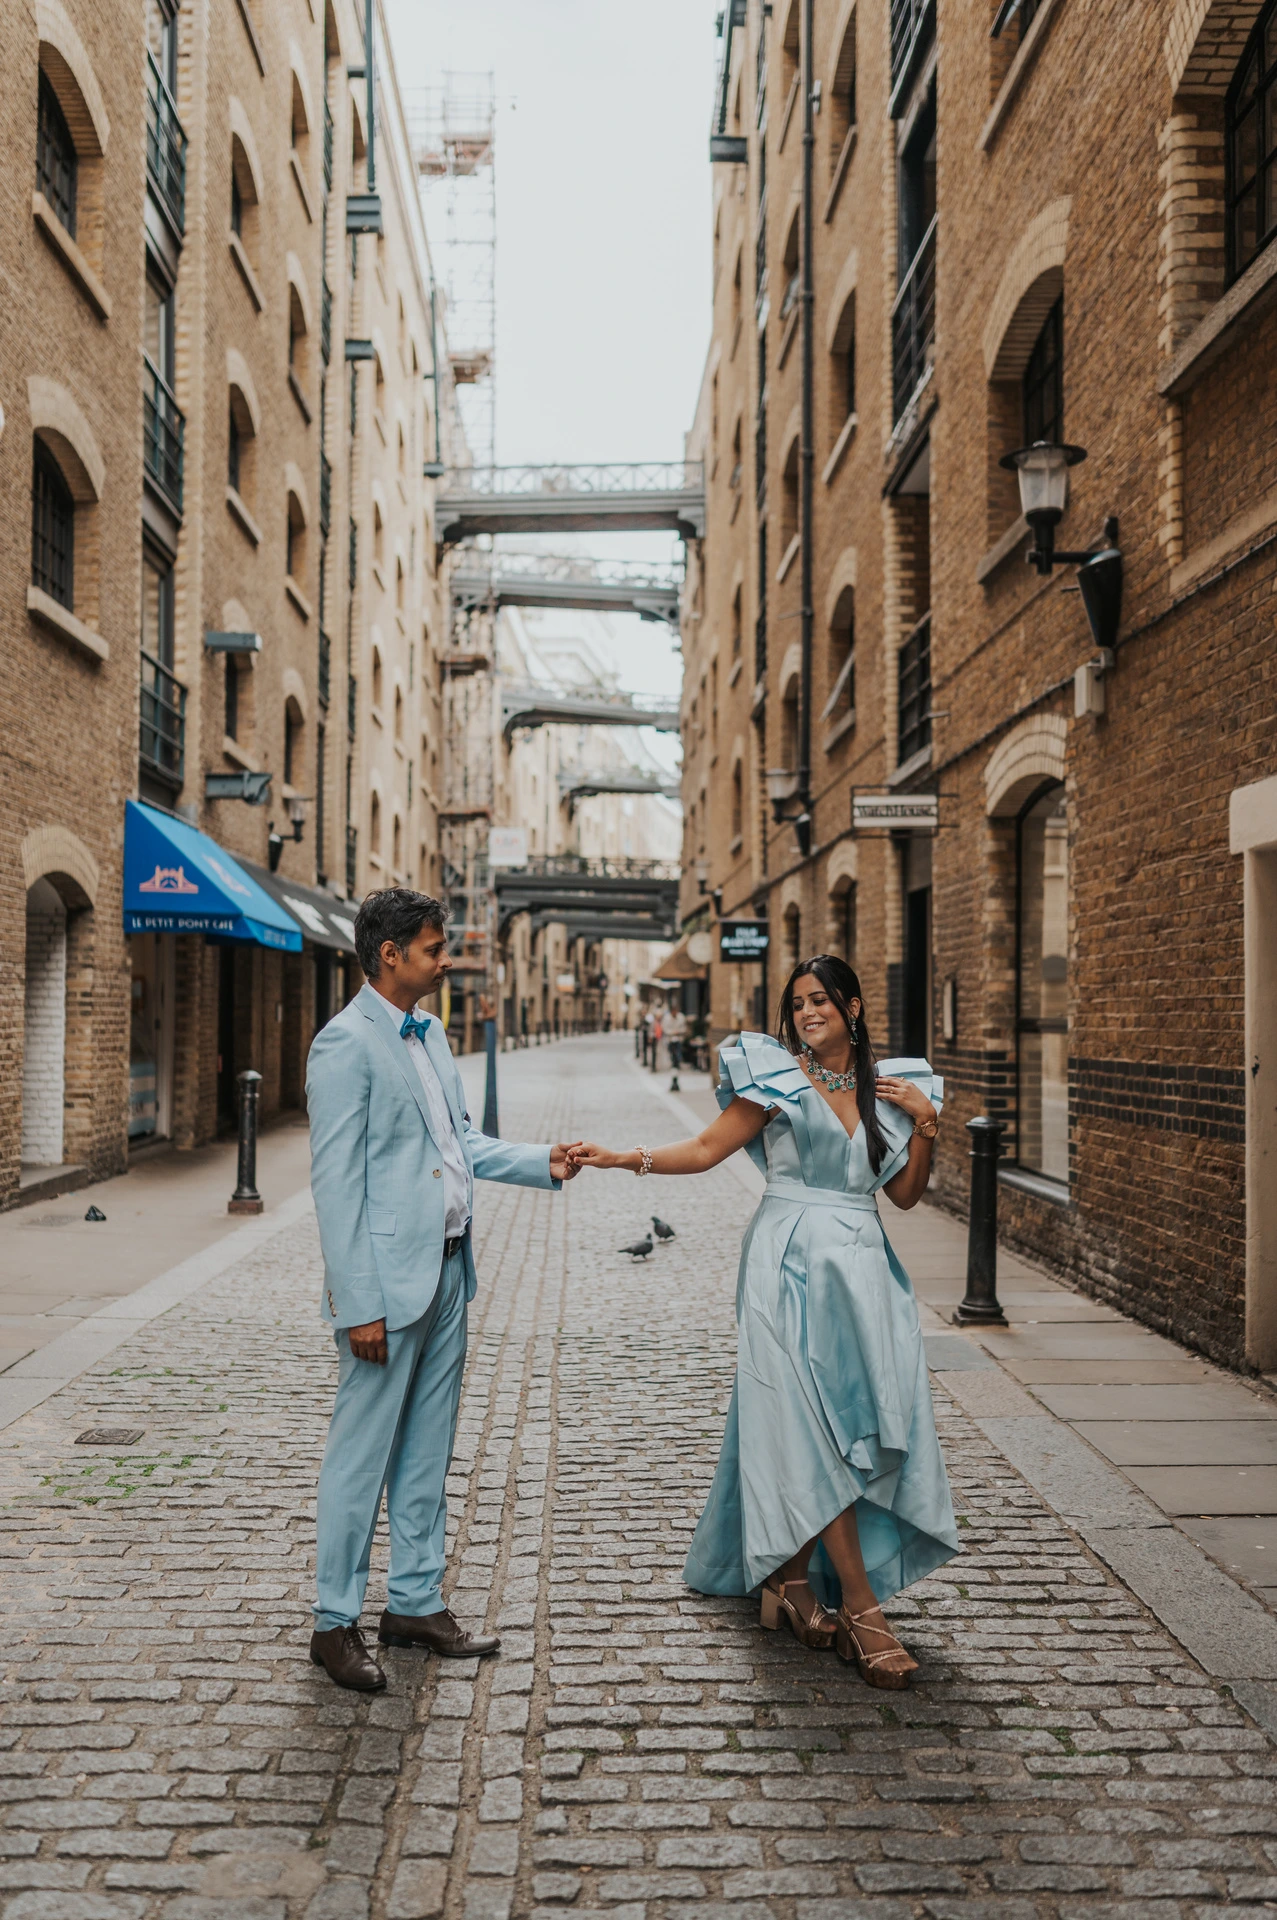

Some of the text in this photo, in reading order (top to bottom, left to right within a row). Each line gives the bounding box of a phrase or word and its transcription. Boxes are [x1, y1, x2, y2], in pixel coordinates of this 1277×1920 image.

[132, 916, 142, 929] LE
[145, 917, 174, 929] PETIT
[178, 917, 210, 930] PONT
